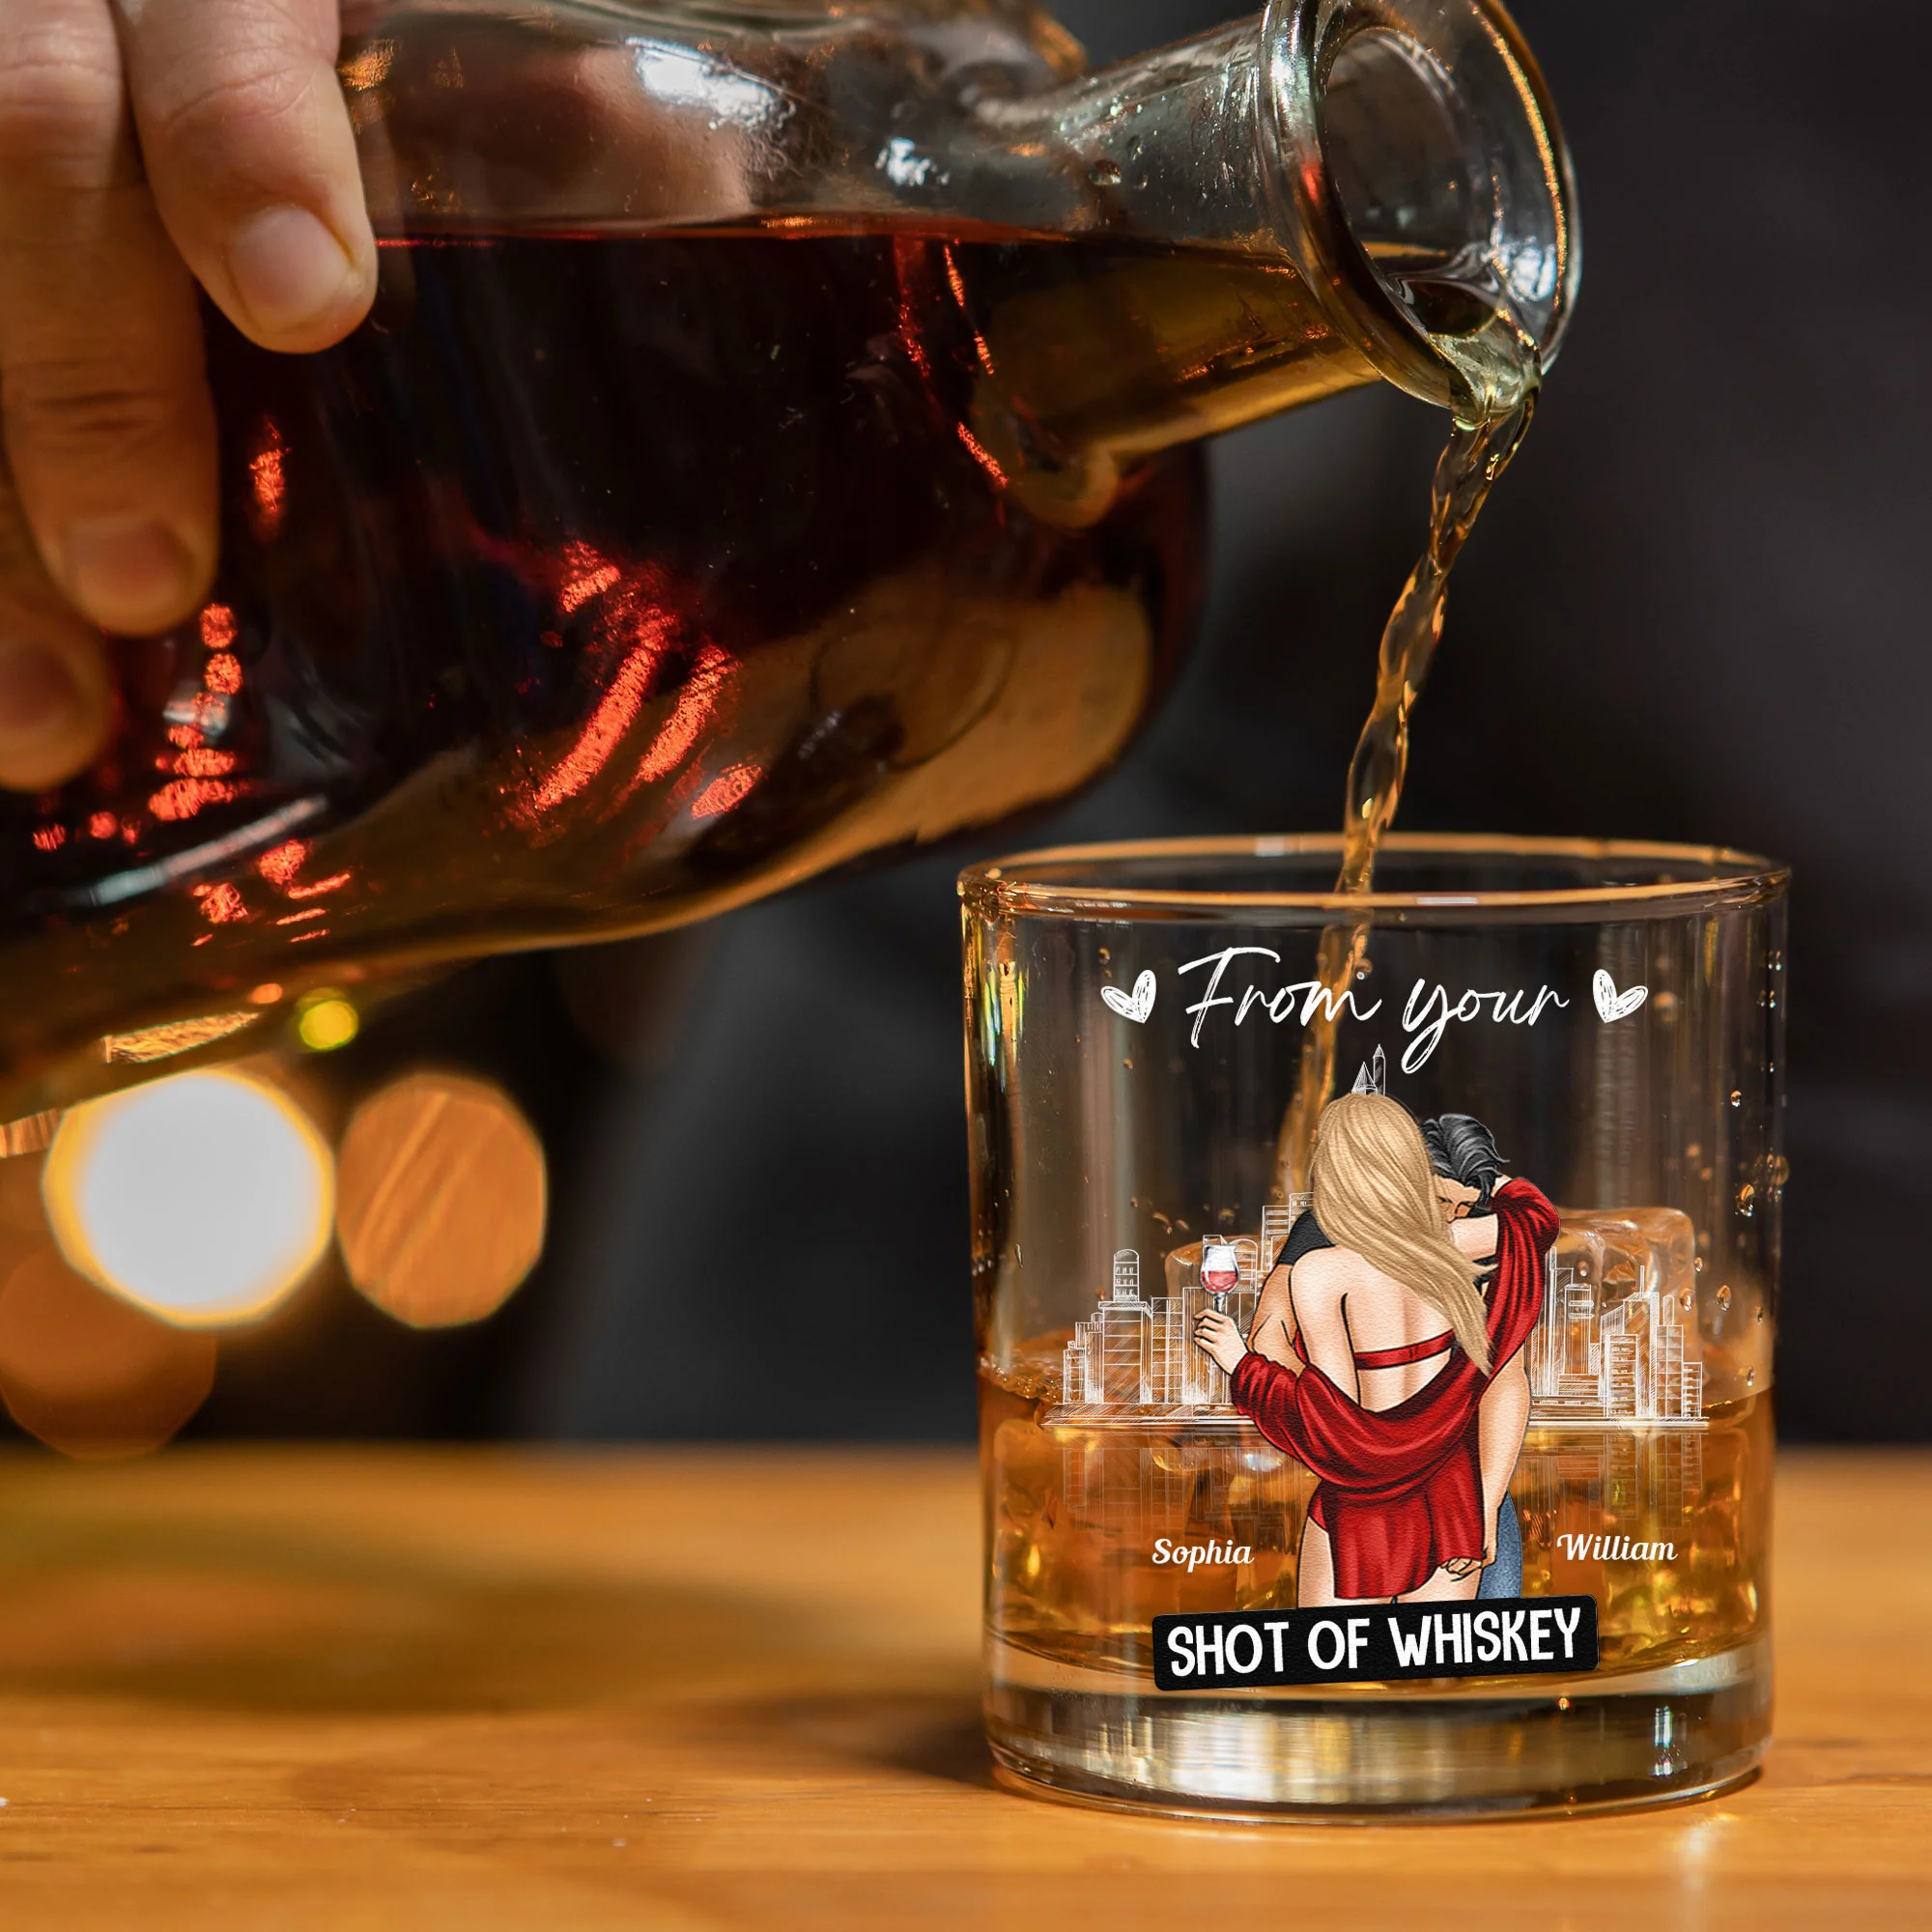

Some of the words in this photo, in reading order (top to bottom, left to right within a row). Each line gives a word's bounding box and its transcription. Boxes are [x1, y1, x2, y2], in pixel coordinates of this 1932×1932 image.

[1178, 947, 1382, 1049] From
[1401, 978, 1570, 1074] your
[1151, 1538, 1255, 1573] Sophia
[1556, 1533, 1679, 1562] William
[1167, 1622, 1291, 1677] SHOT
[1307, 1618, 1371, 1670] OF
[1387, 1606, 1581, 1667] WHISKEY
